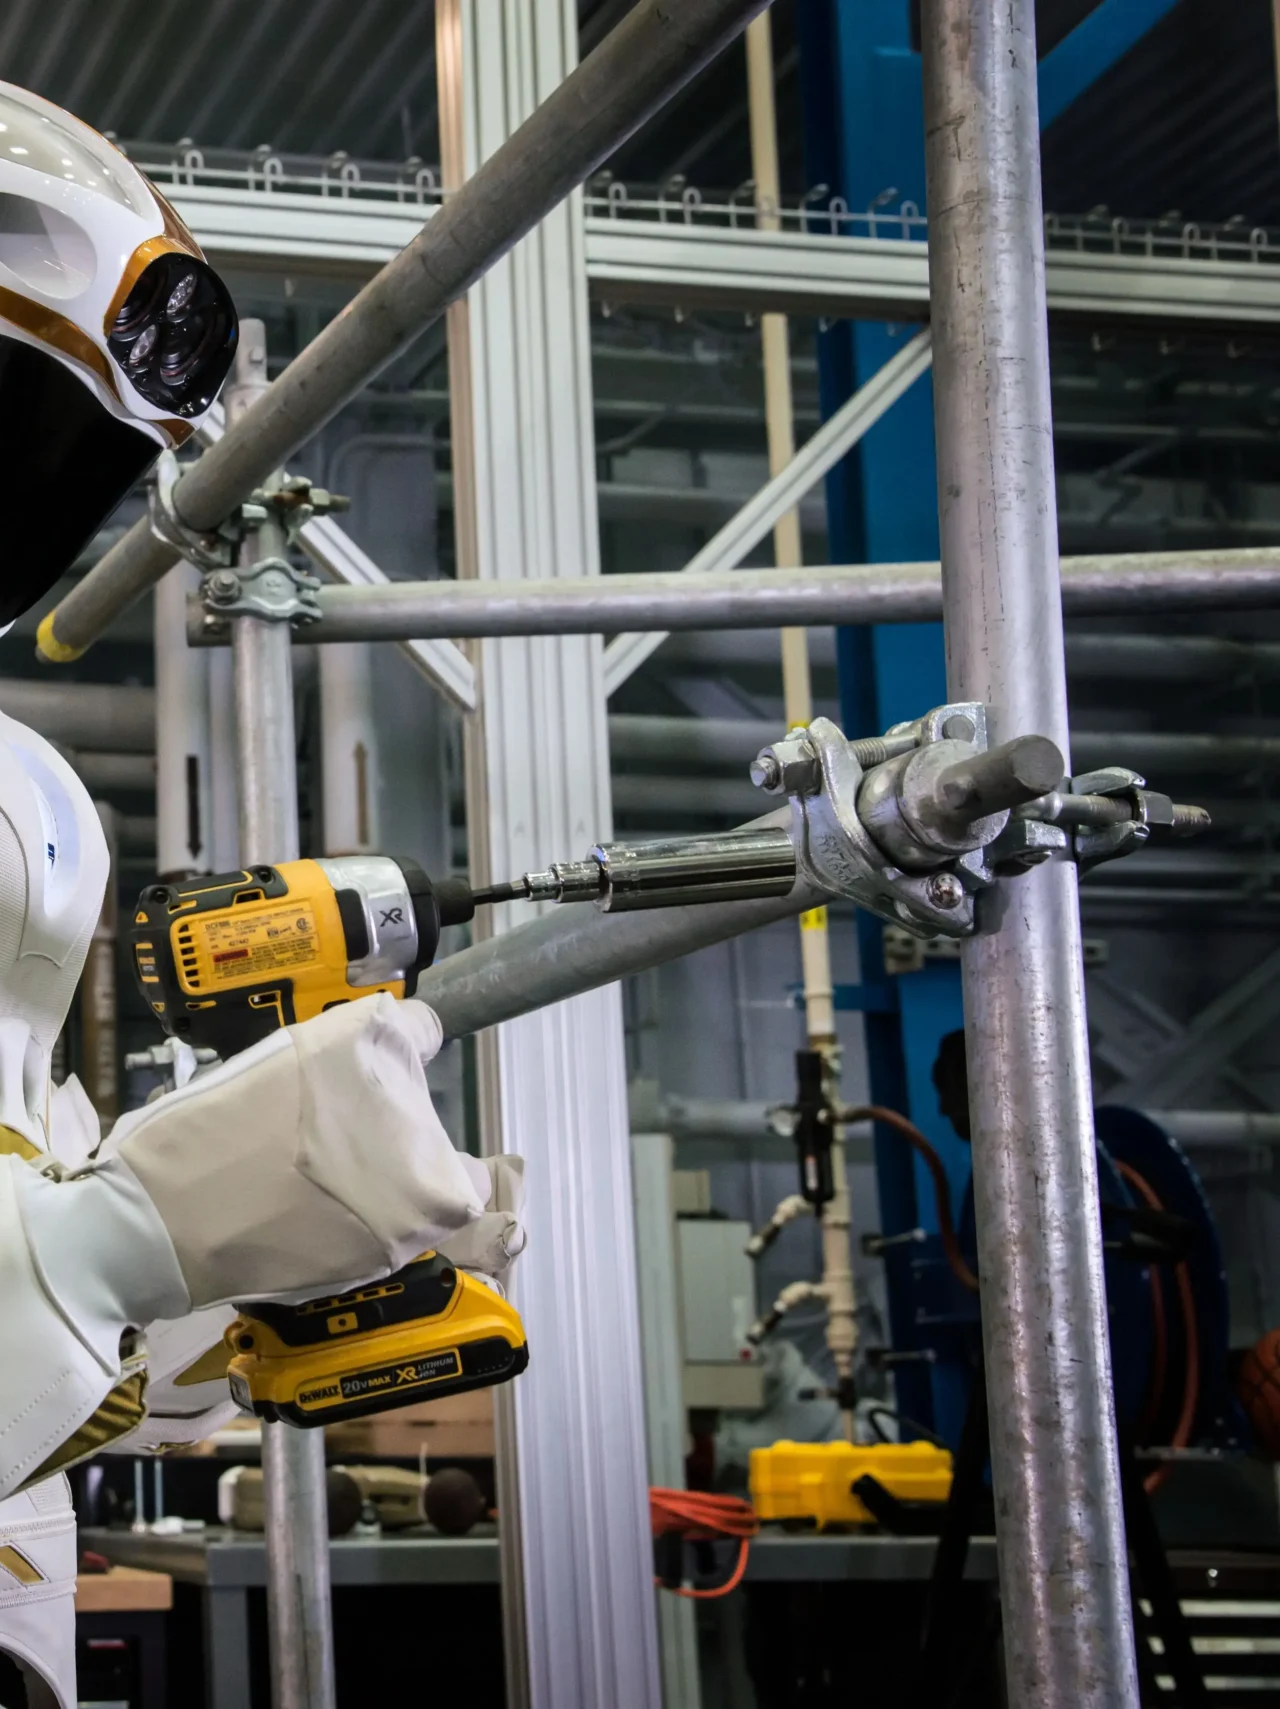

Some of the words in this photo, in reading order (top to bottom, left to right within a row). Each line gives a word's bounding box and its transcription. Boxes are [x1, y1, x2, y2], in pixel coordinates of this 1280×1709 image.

[379, 907, 406, 928] XR
[395, 1366, 419, 1384] XR
[418, 1356, 454, 1371] LITHIUM
